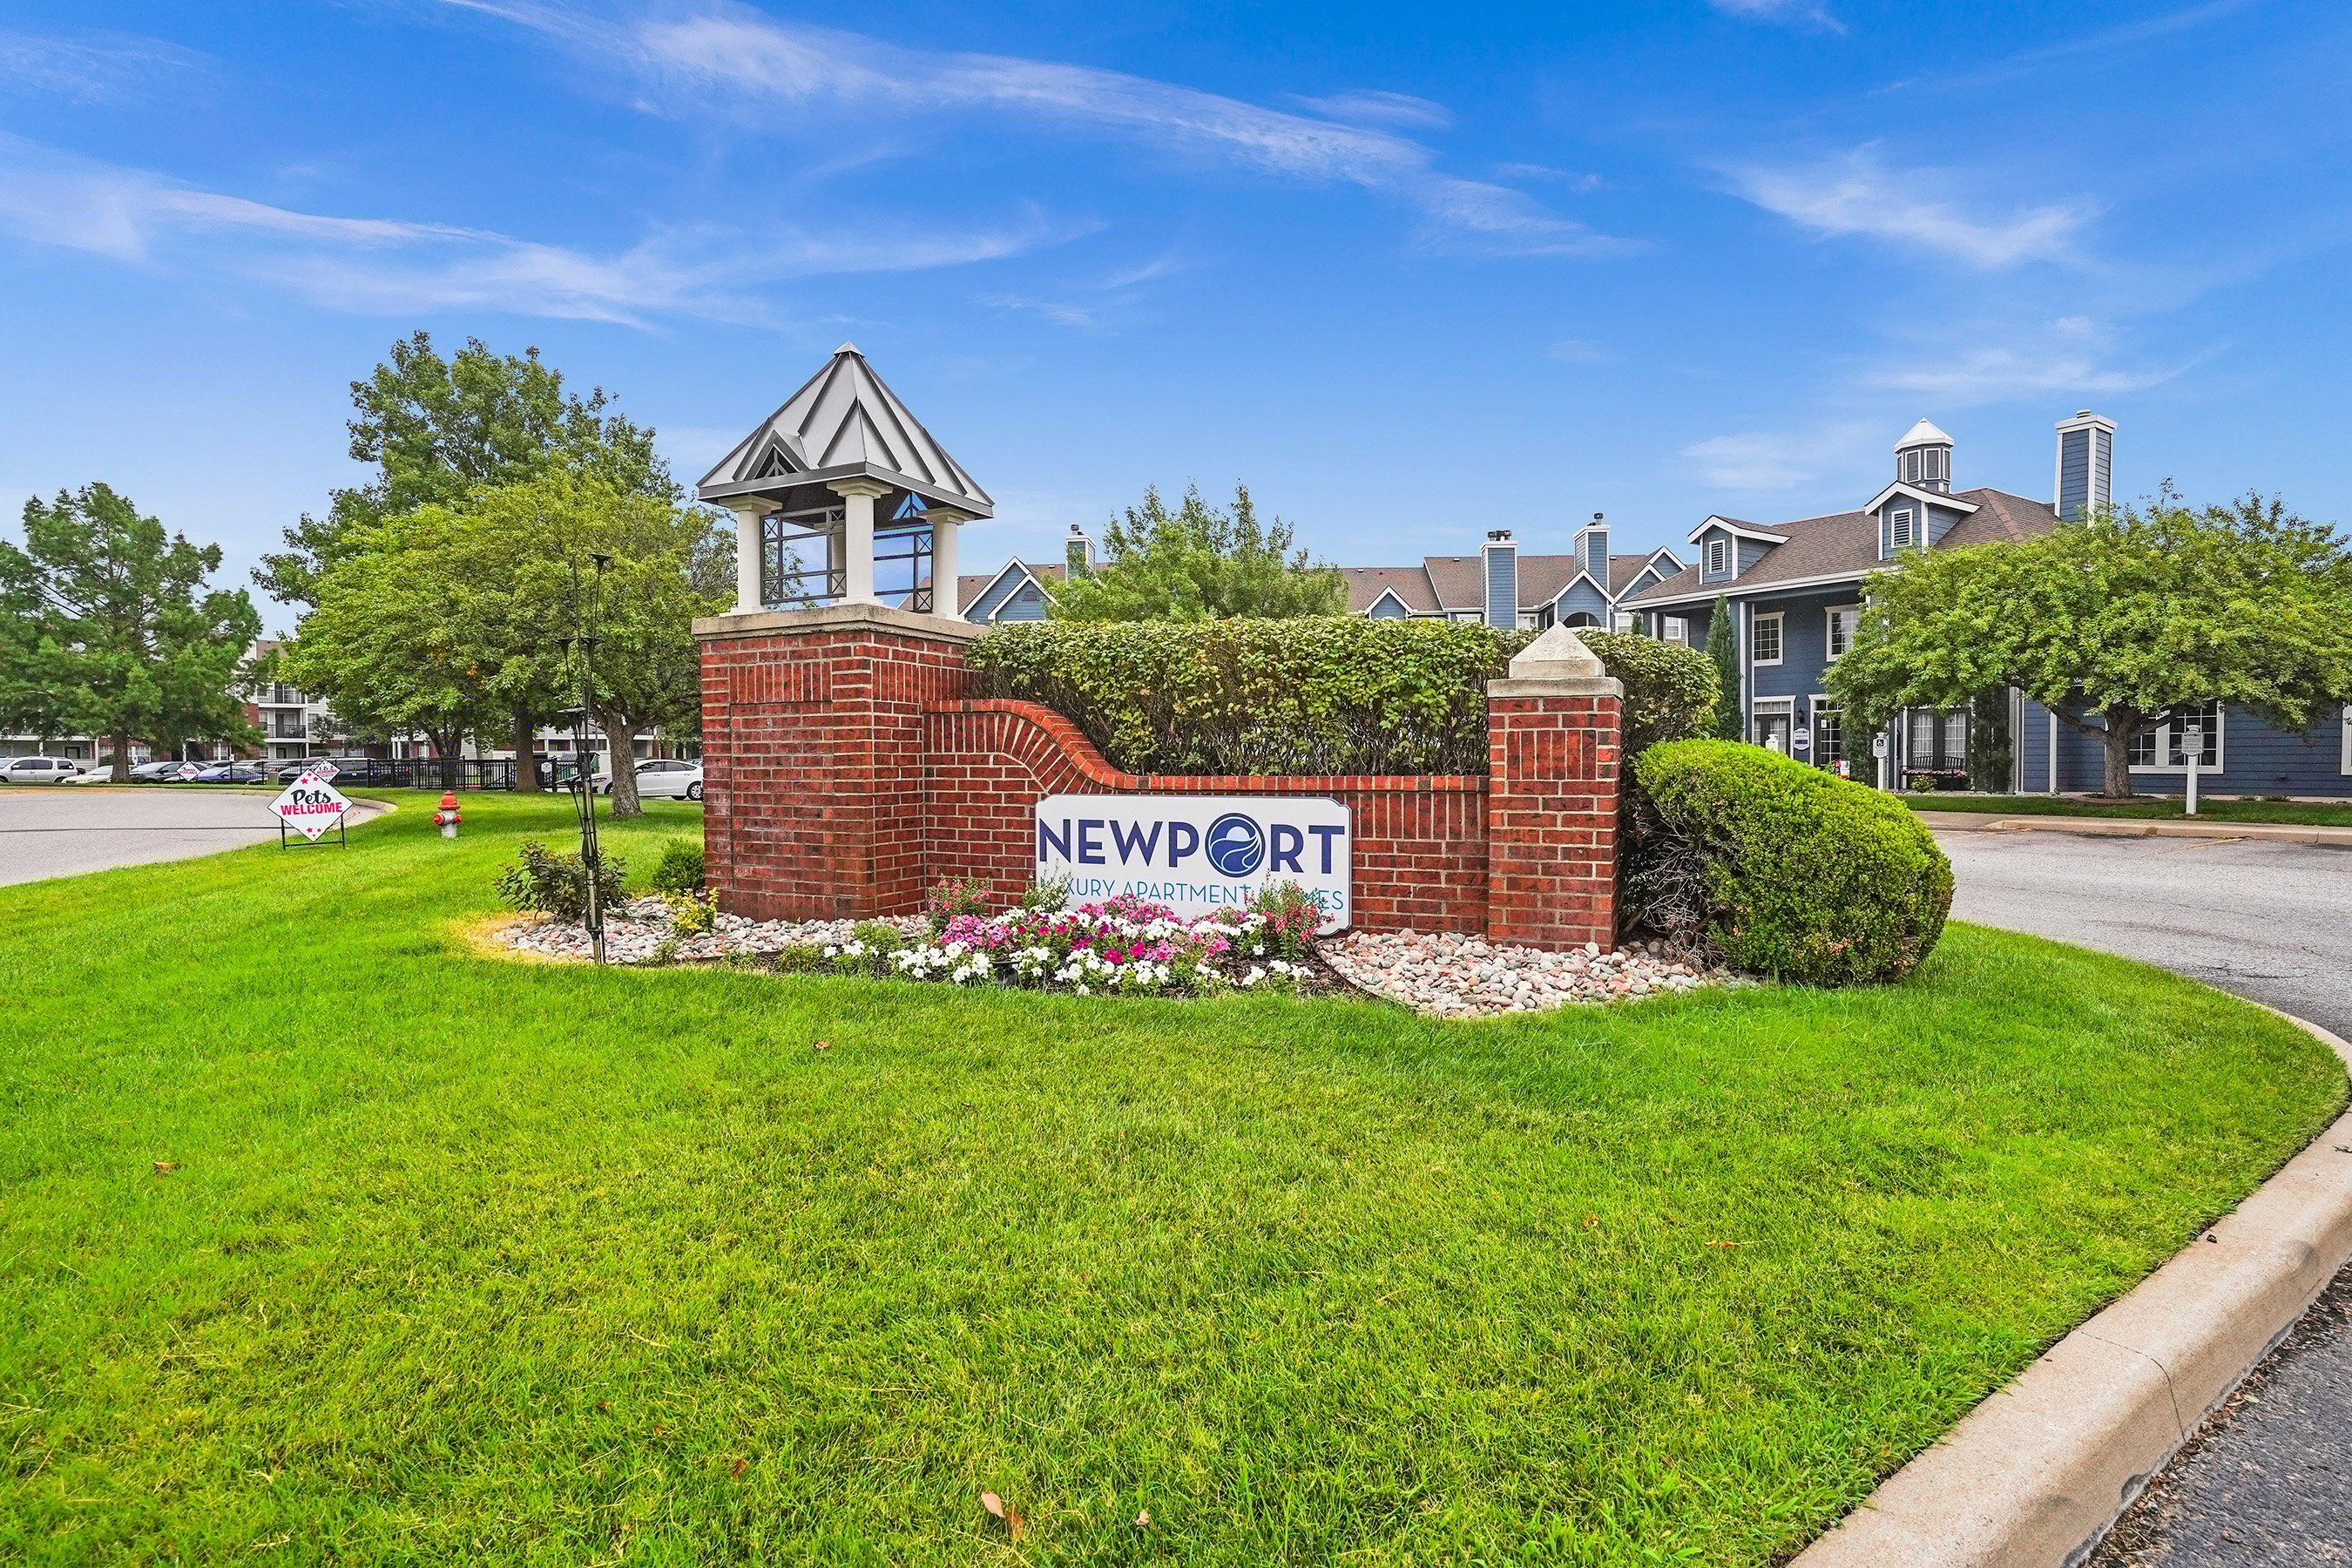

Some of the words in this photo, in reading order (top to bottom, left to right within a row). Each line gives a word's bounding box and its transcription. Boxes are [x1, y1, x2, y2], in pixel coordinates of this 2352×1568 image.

[291, 789, 331, 805] Pets
[280, 802, 343, 815] WELCOME
[1038, 812, 1346, 878] NEWPORT
[1040, 877, 1115, 897] XURY
